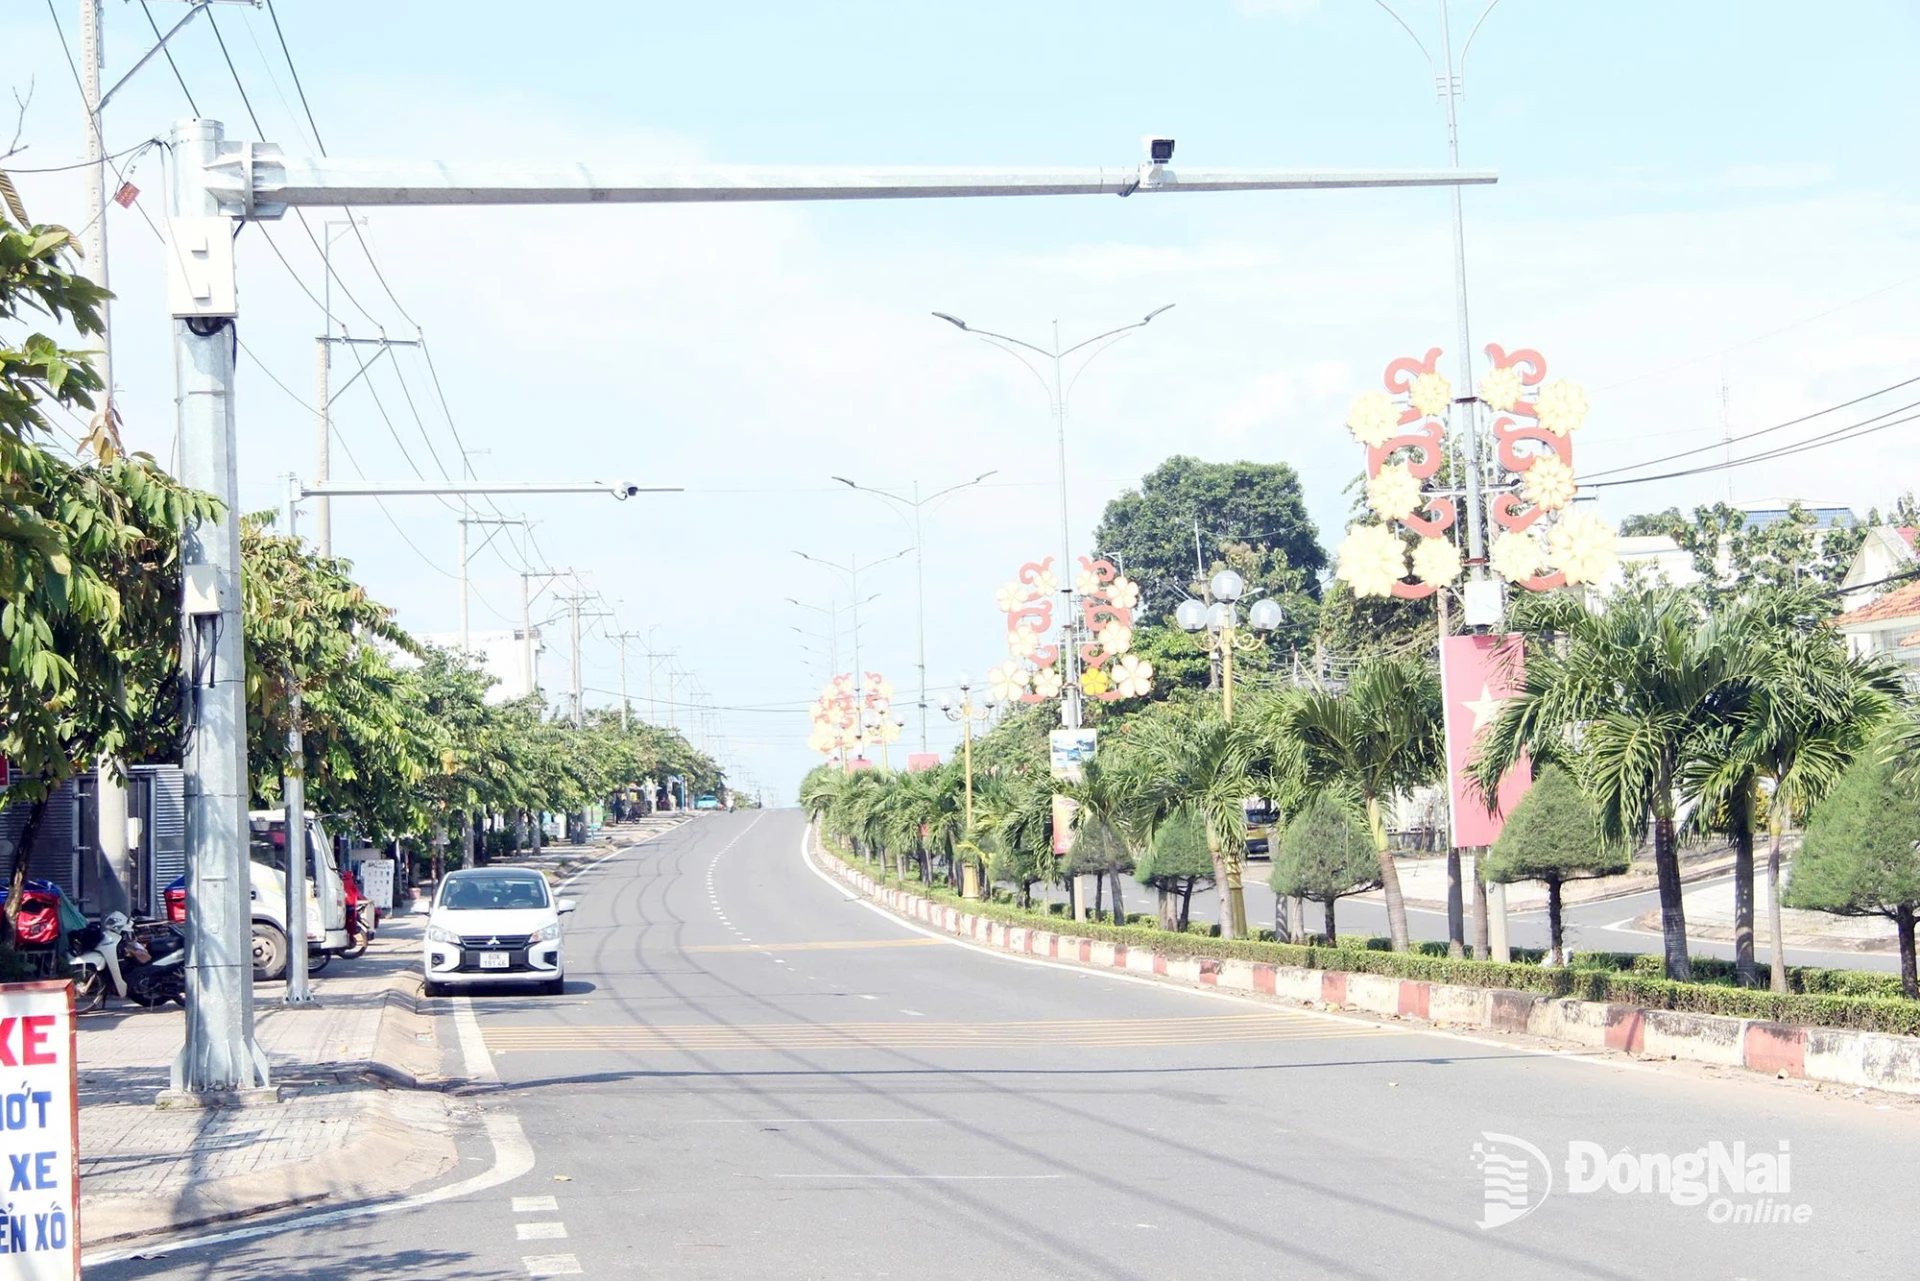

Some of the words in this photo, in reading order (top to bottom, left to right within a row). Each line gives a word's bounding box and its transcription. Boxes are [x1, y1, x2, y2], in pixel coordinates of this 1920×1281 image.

[0, 1080, 52, 1131] ỚT
[9, 1151, 57, 1191] XE
[34, 1200, 66, 1251] XỐ
